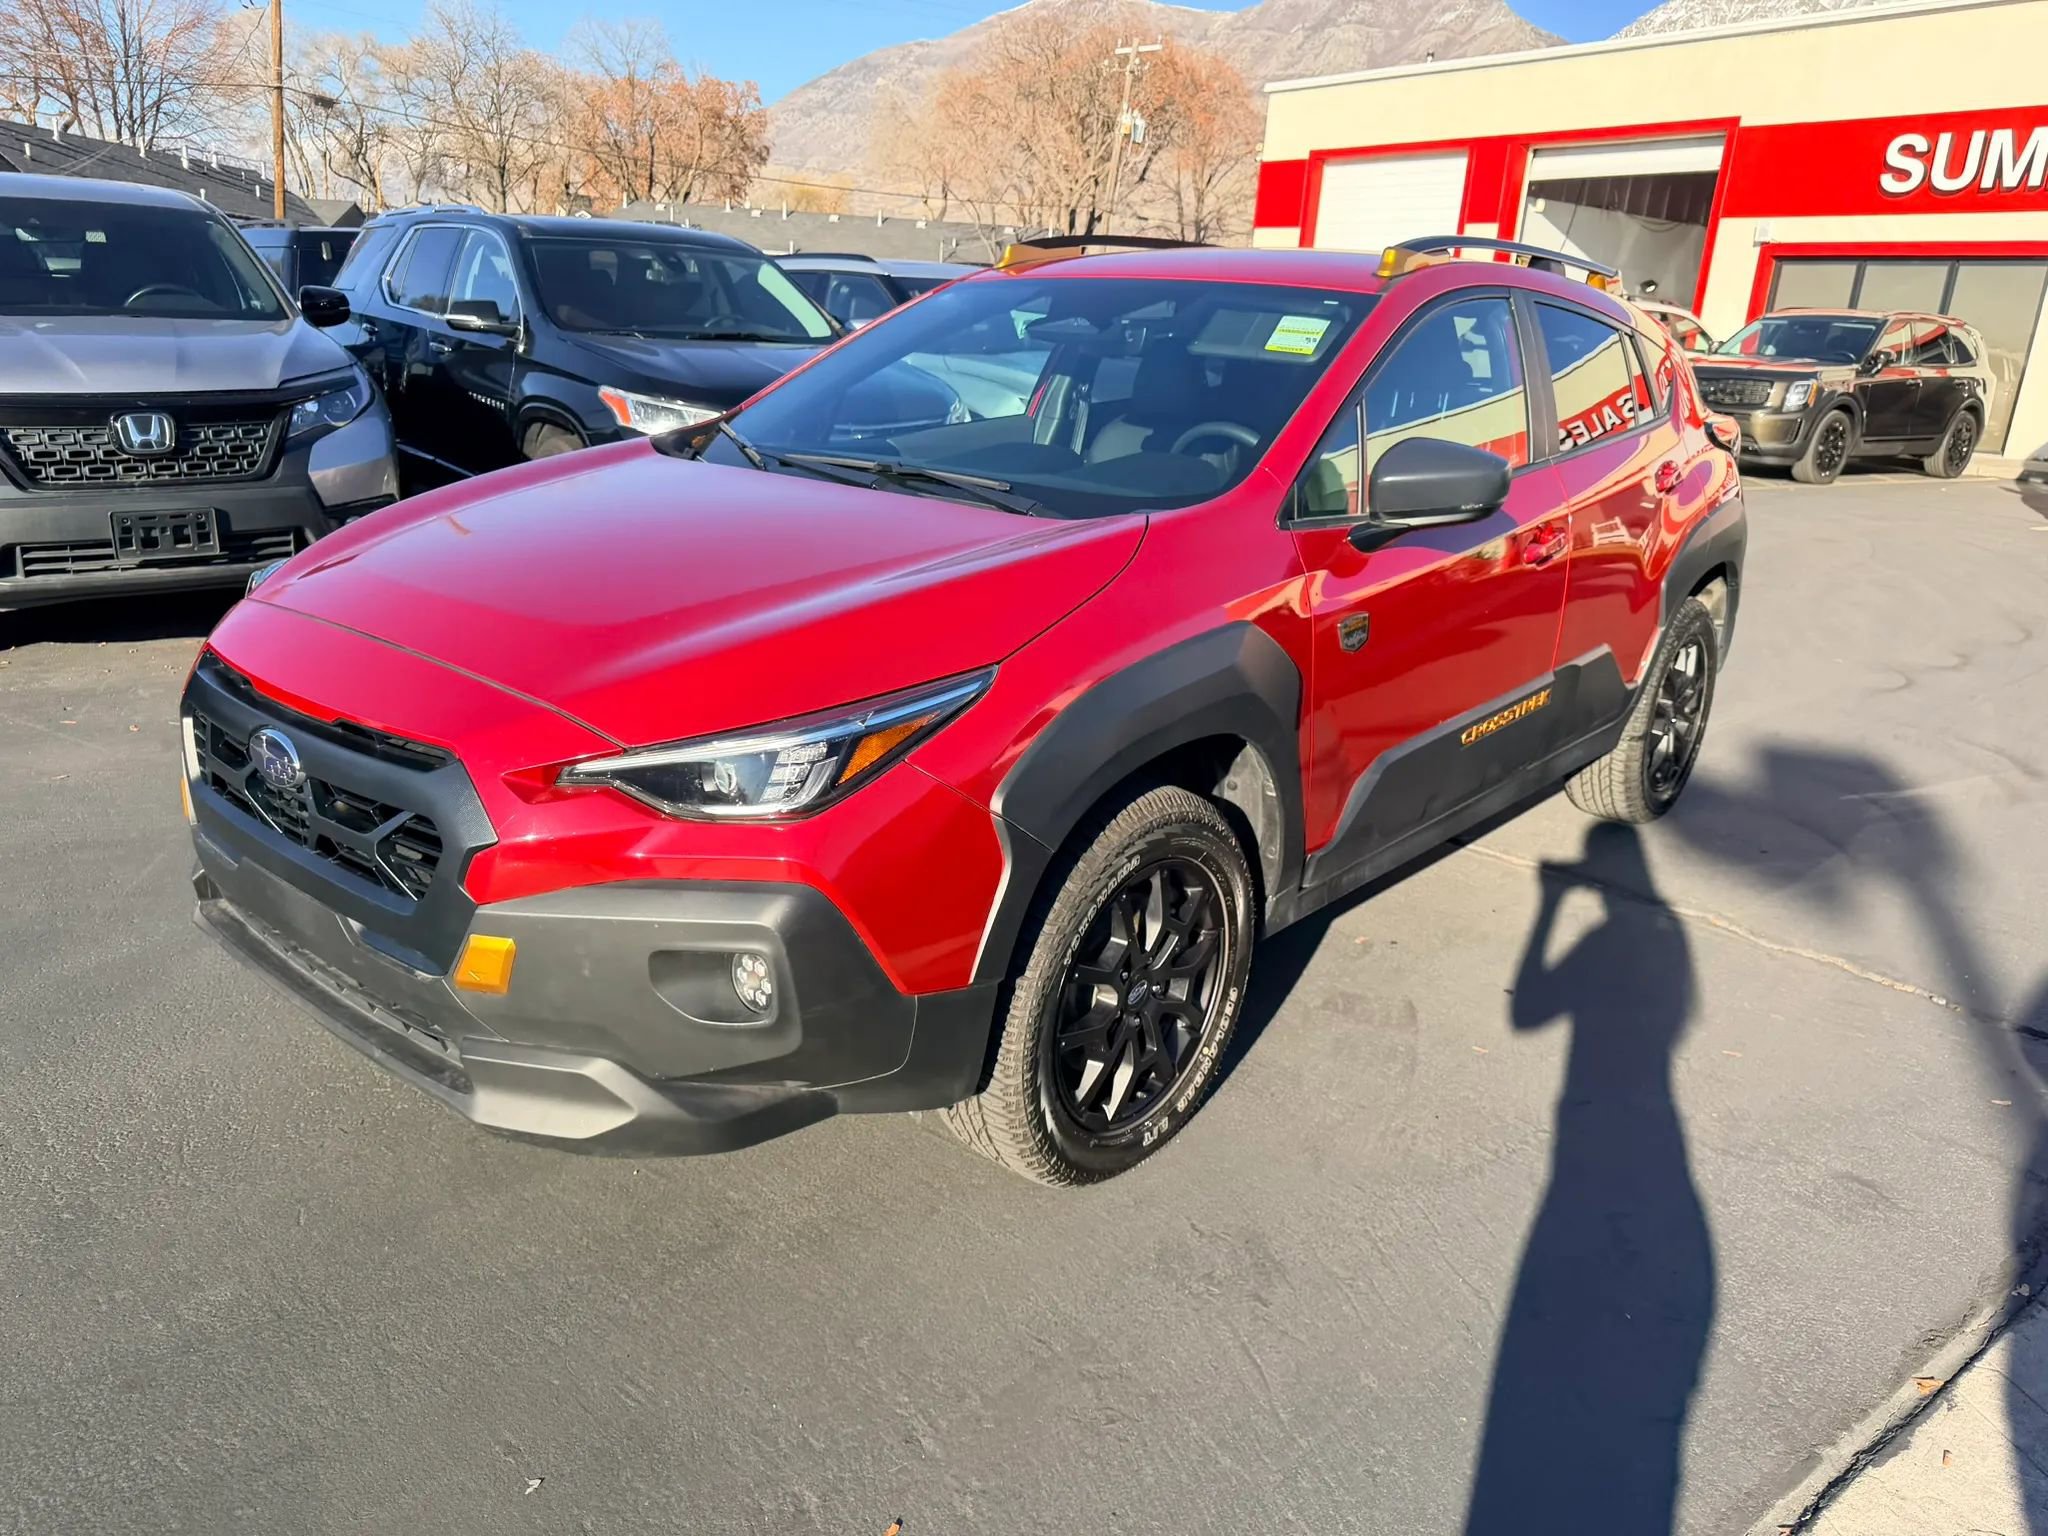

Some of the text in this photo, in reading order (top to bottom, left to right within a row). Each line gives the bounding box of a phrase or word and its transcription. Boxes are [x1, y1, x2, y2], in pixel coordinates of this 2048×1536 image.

[1879, 125, 2048, 196] SUM
[1460, 689, 1552, 745] CROSSTREK
[1064, 854, 1141, 966] YOKOHAMA
[1178, 987, 1239, 1113] GEOLANDAR
